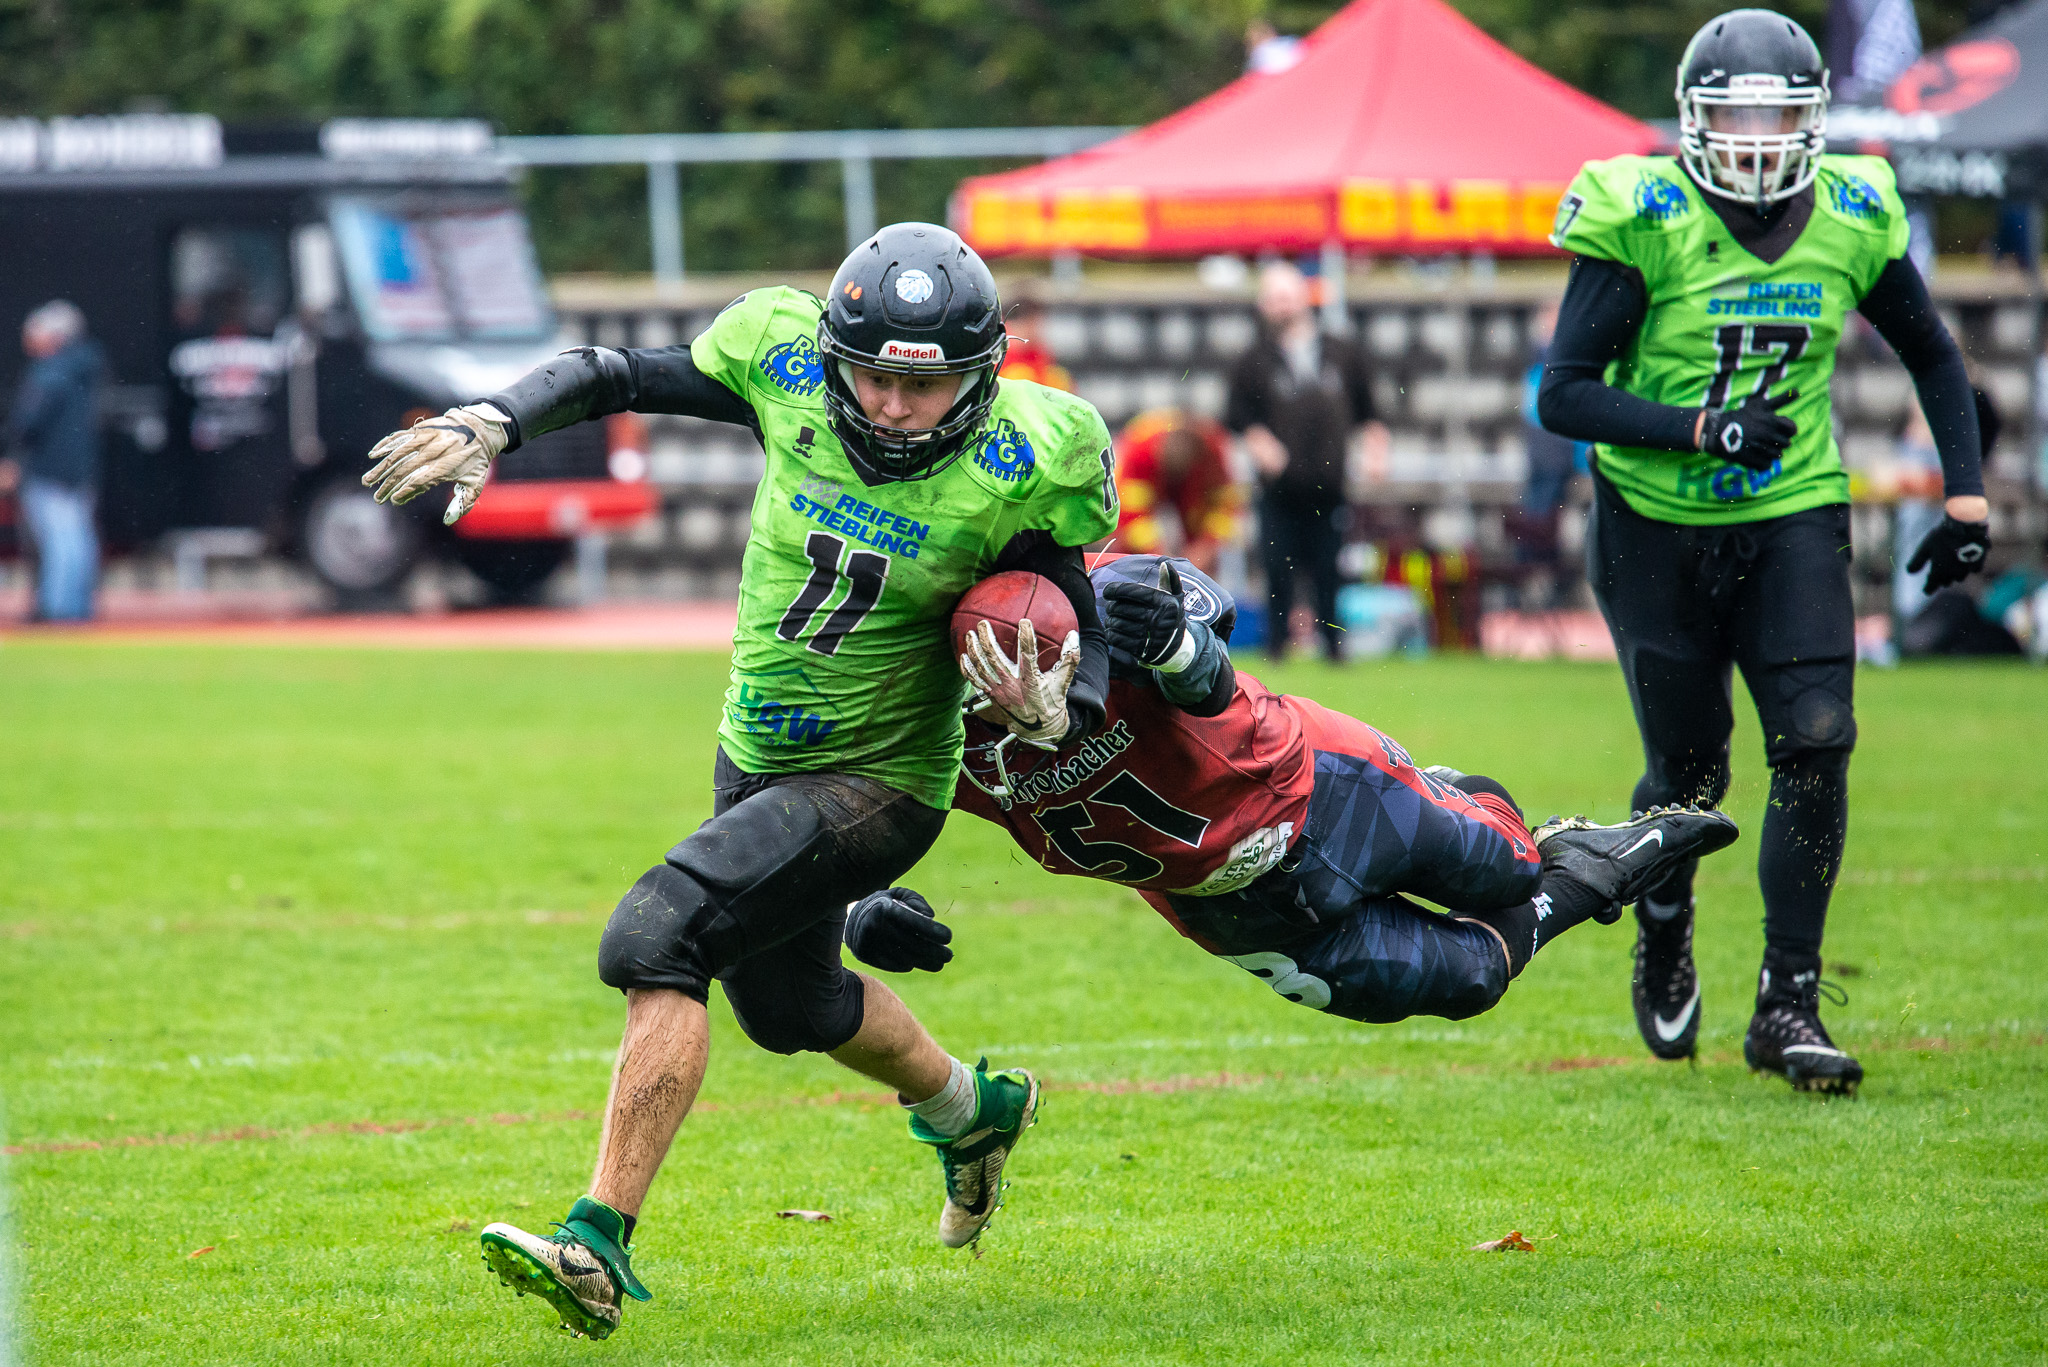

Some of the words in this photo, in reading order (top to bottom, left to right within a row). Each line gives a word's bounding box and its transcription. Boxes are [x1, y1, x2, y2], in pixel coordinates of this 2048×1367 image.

[1706, 298, 1821, 318] STIEBLING
[1748, 282, 1823, 299] REIFEN
[888, 346, 938, 360] Riddell
[1700, 321, 1813, 412] 17
[758, 358, 816, 397] SECURITY
[973, 453, 1034, 482] SECURITY
[789, 494, 921, 560] STIEBLING
[835, 493, 930, 541] REIFEN
[775, 530, 892, 658] 11
[740, 681, 841, 746] HGW
